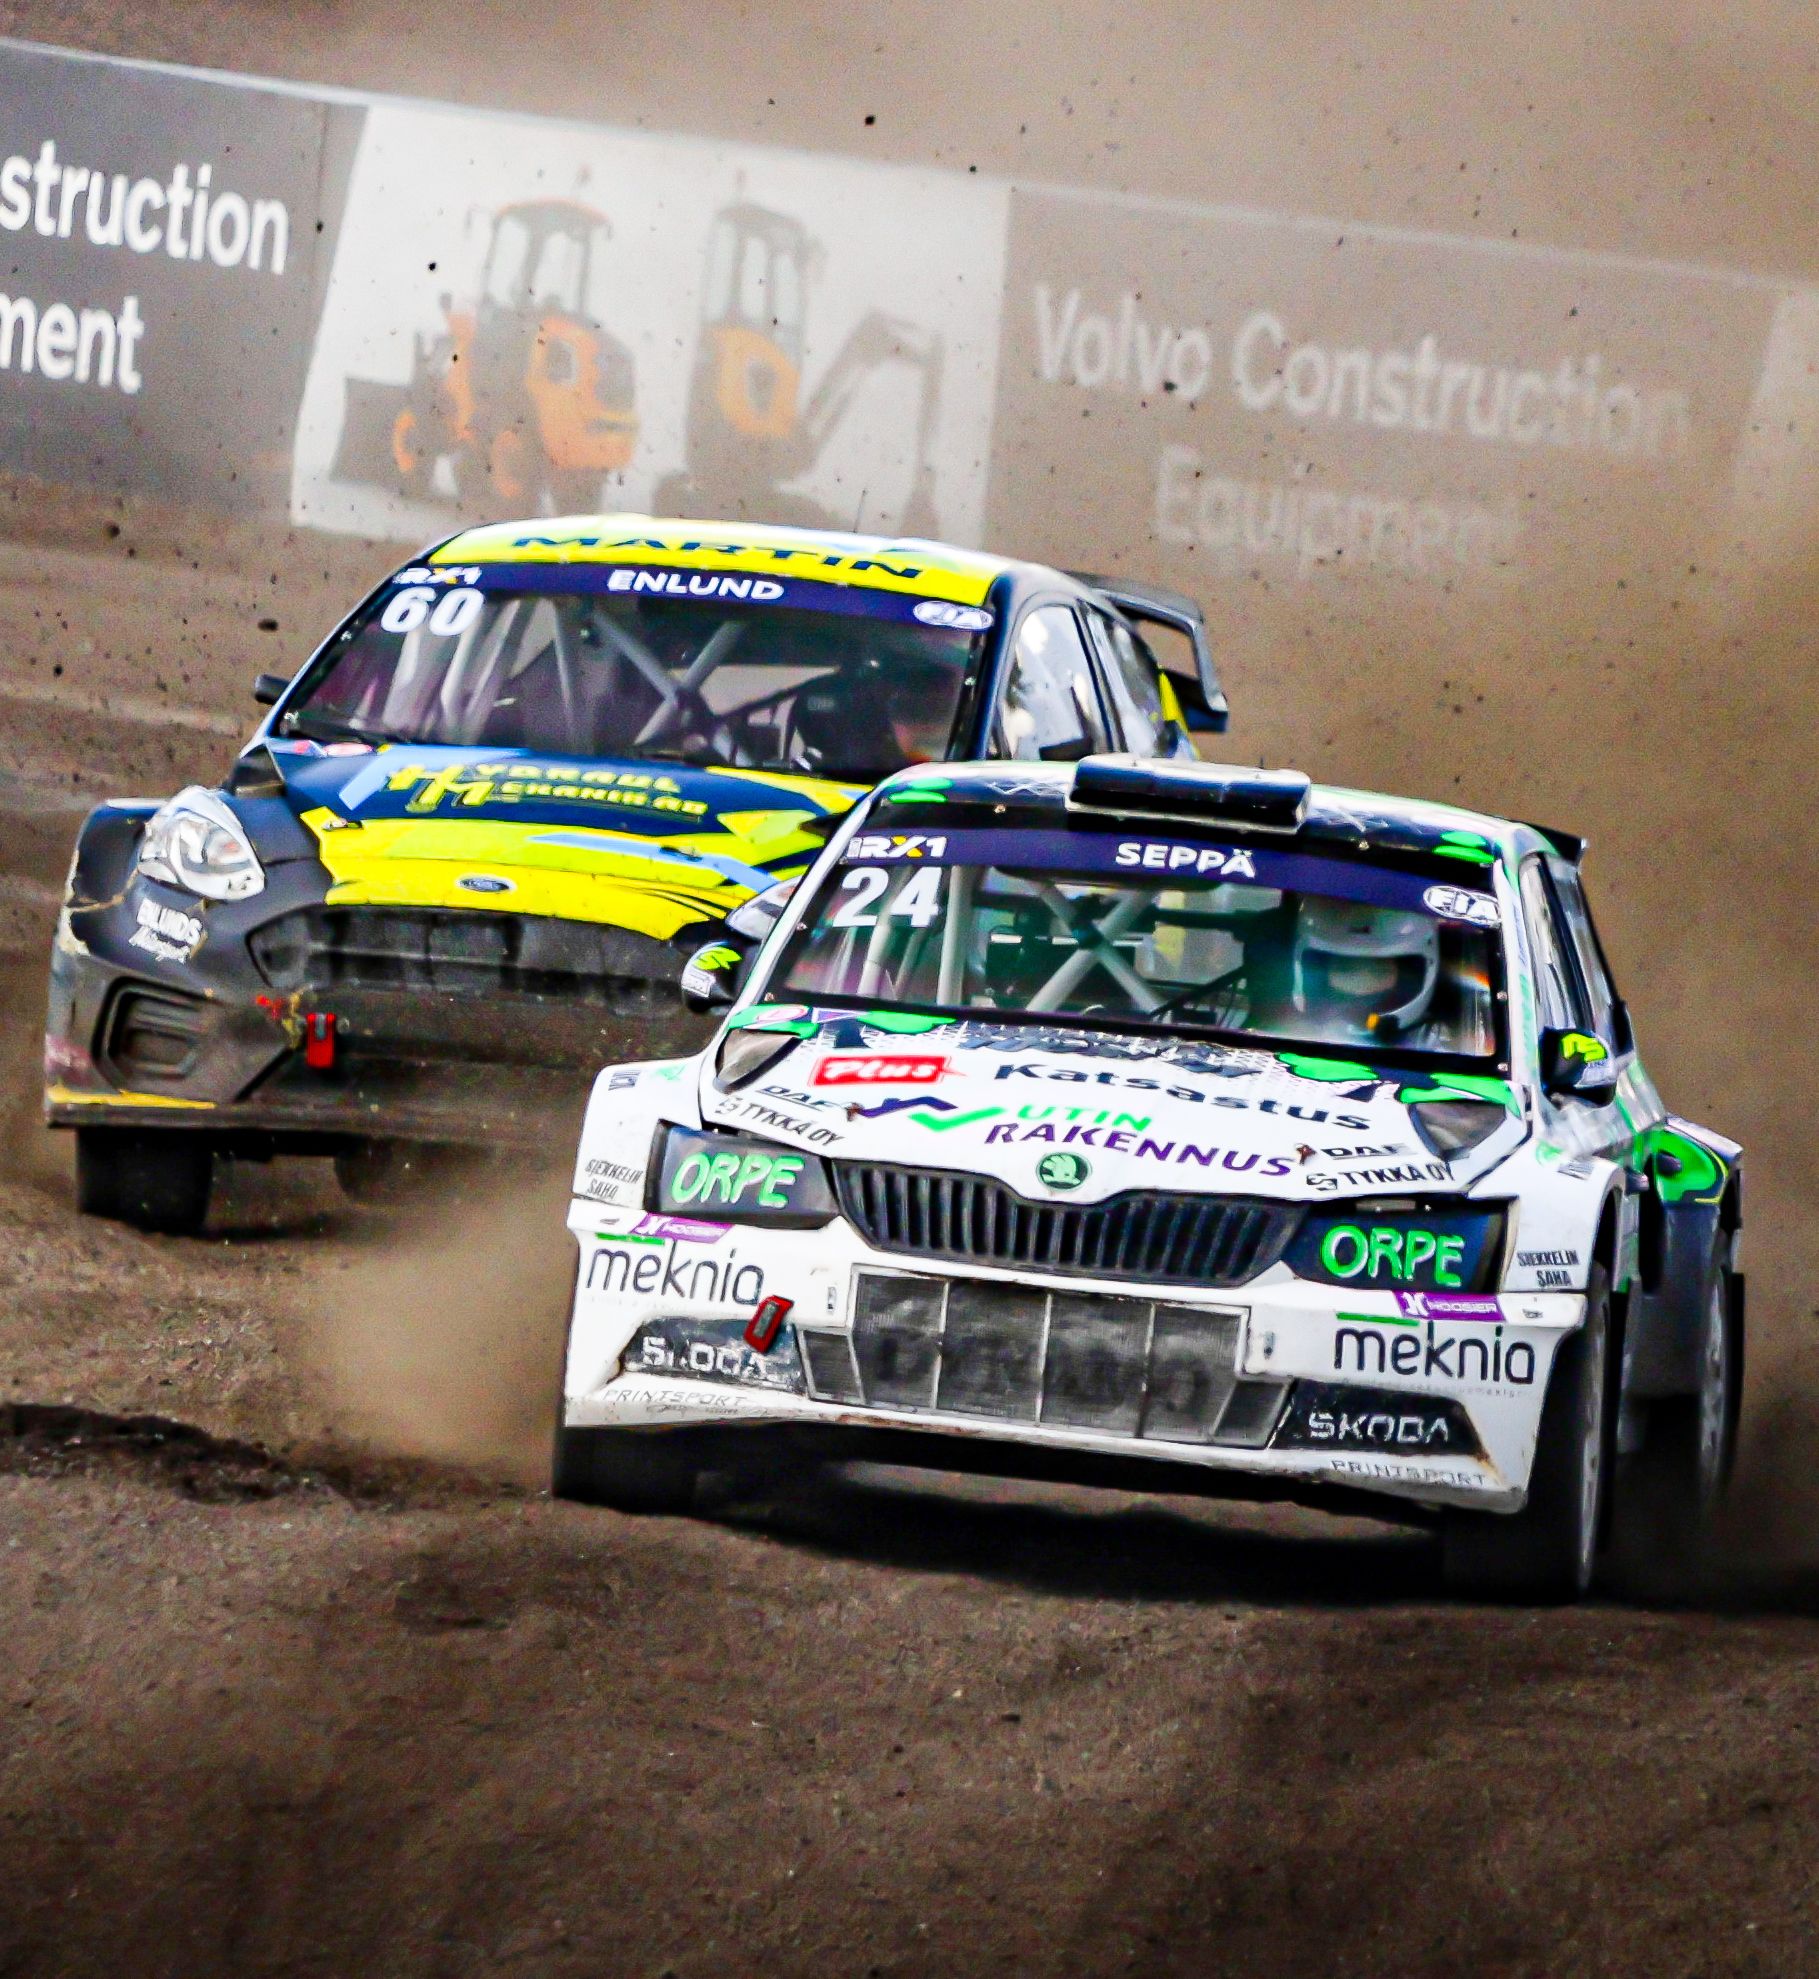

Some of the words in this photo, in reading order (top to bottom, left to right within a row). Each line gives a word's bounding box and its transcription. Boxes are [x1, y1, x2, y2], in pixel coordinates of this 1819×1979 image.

[0, 139, 289, 275] struction
[1033, 287, 1212, 399] Volvo
[1231, 311, 1692, 457] Construction
[512, 537, 922, 579] MARTIN
[606, 569, 785, 601] ENLUND
[380, 586, 485, 636] 60
[1115, 841, 1256, 880] SEPPÄ
[832, 866, 943, 928] 24
[1430, 889, 1499, 921] FIA
[821, 1060, 935, 1082] Plus
[994, 1063, 1372, 1132] Katsastus
[1017, 1104, 1152, 1132] UTIN
[985, 1123, 1296, 1178] RAKENNUS
[671, 1151, 806, 1209] ORPE
[1321, 1225, 1466, 1288] ORPE
[1308, 1412, 1449, 1444] SKODA
